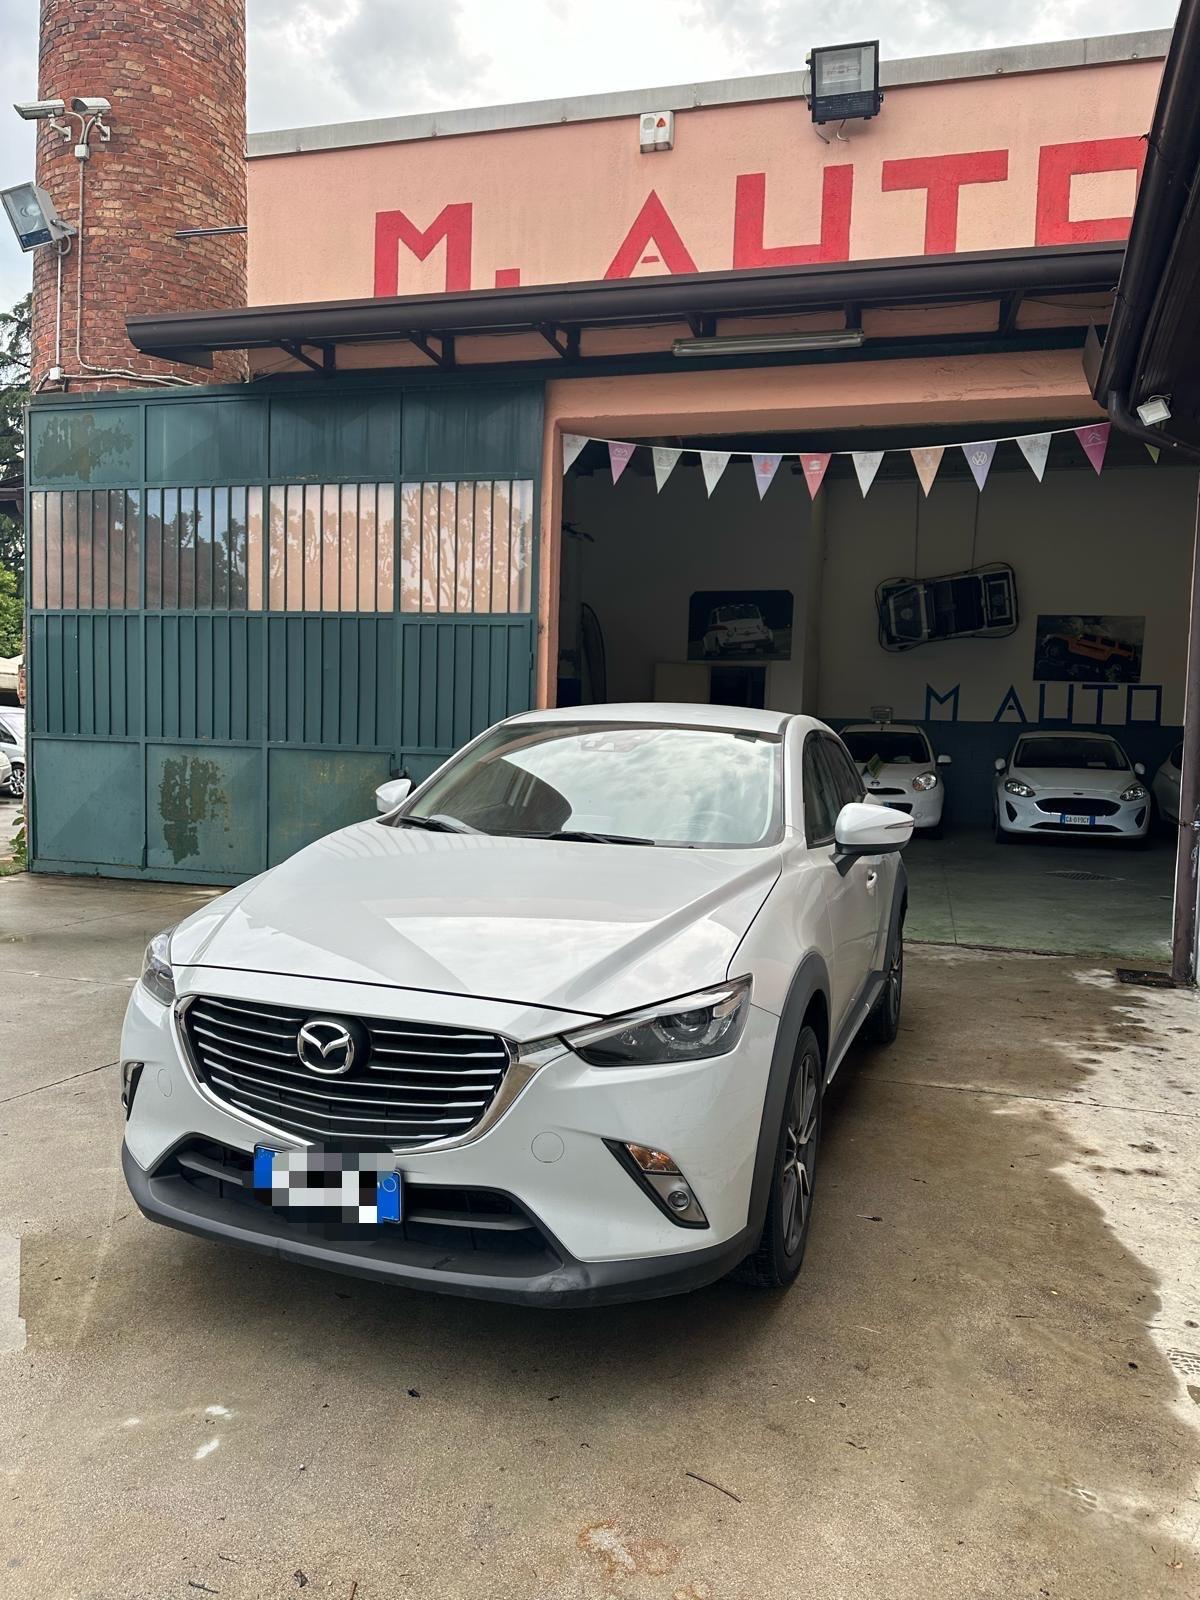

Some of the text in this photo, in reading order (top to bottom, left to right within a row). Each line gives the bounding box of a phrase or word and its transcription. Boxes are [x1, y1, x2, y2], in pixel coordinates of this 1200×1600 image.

[604, 136, 1147, 281] AUTO
[925, 683, 1162, 726] M AUTO
